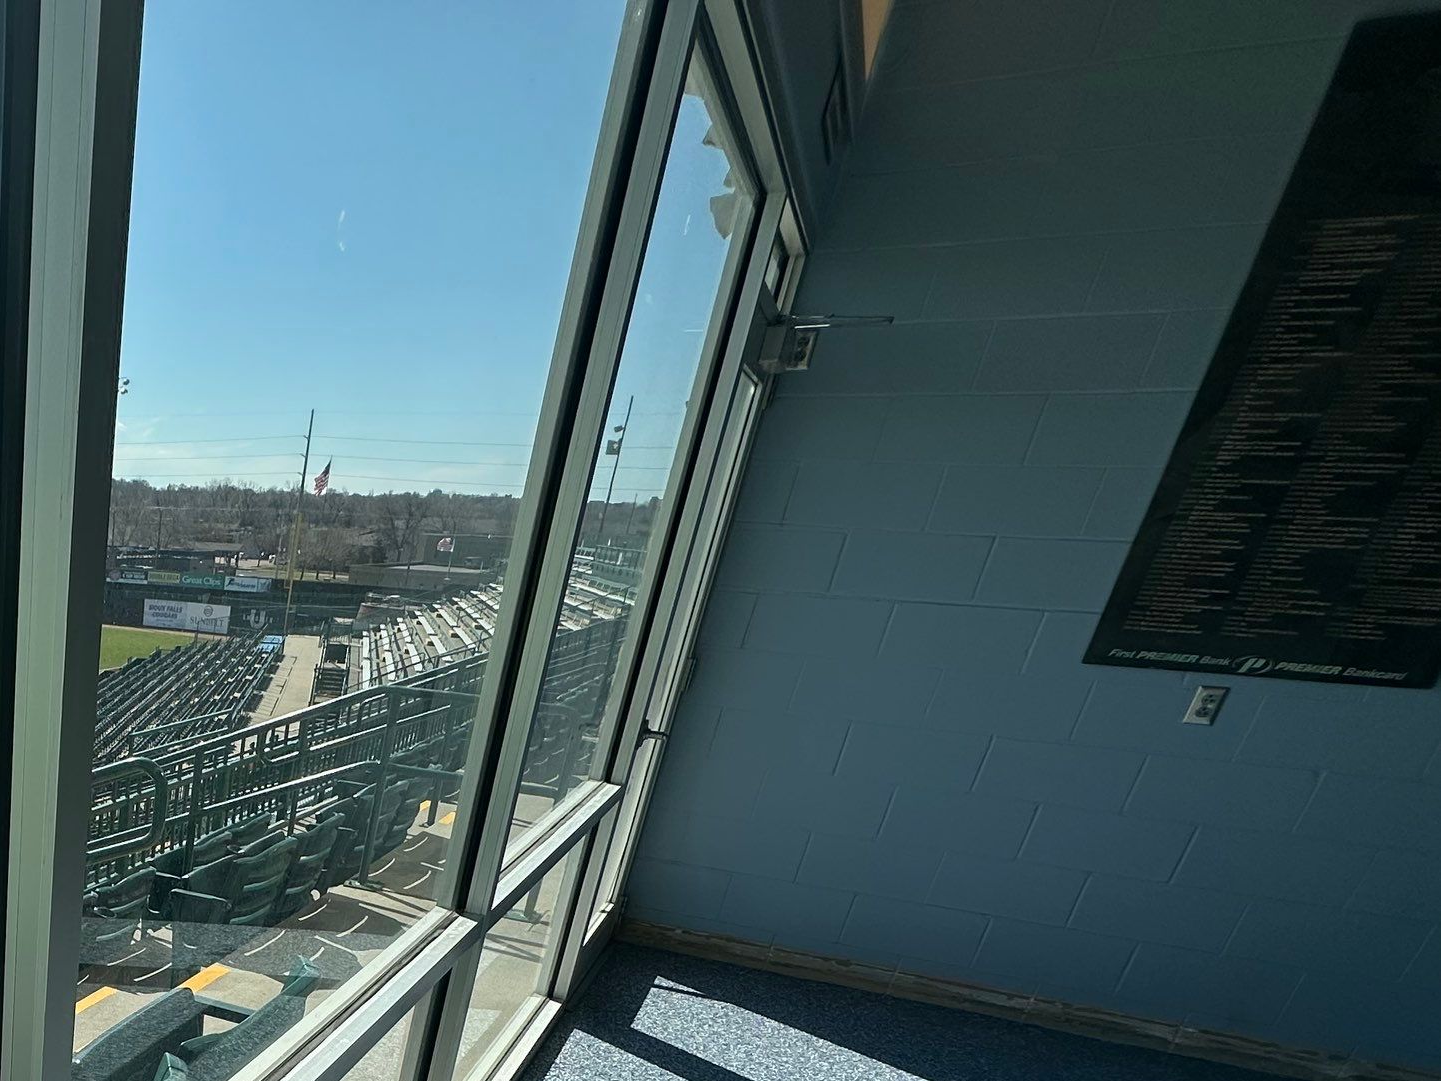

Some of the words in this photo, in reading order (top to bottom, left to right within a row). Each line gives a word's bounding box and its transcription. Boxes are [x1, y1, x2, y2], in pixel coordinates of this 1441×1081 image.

[181, 575, 202, 584] Great
[203, 577, 222, 587] Clips
[148, 603, 166, 612] SIOUX
[166, 604, 183, 614] FALLS
[1108, 648, 1137, 660] First
[1137, 650, 1197, 664] PREMIER
[1199, 655, 1231, 667] Bank
[1275, 661, 1342, 676] PREMIER
[1343, 666, 1408, 681] Bankcard
